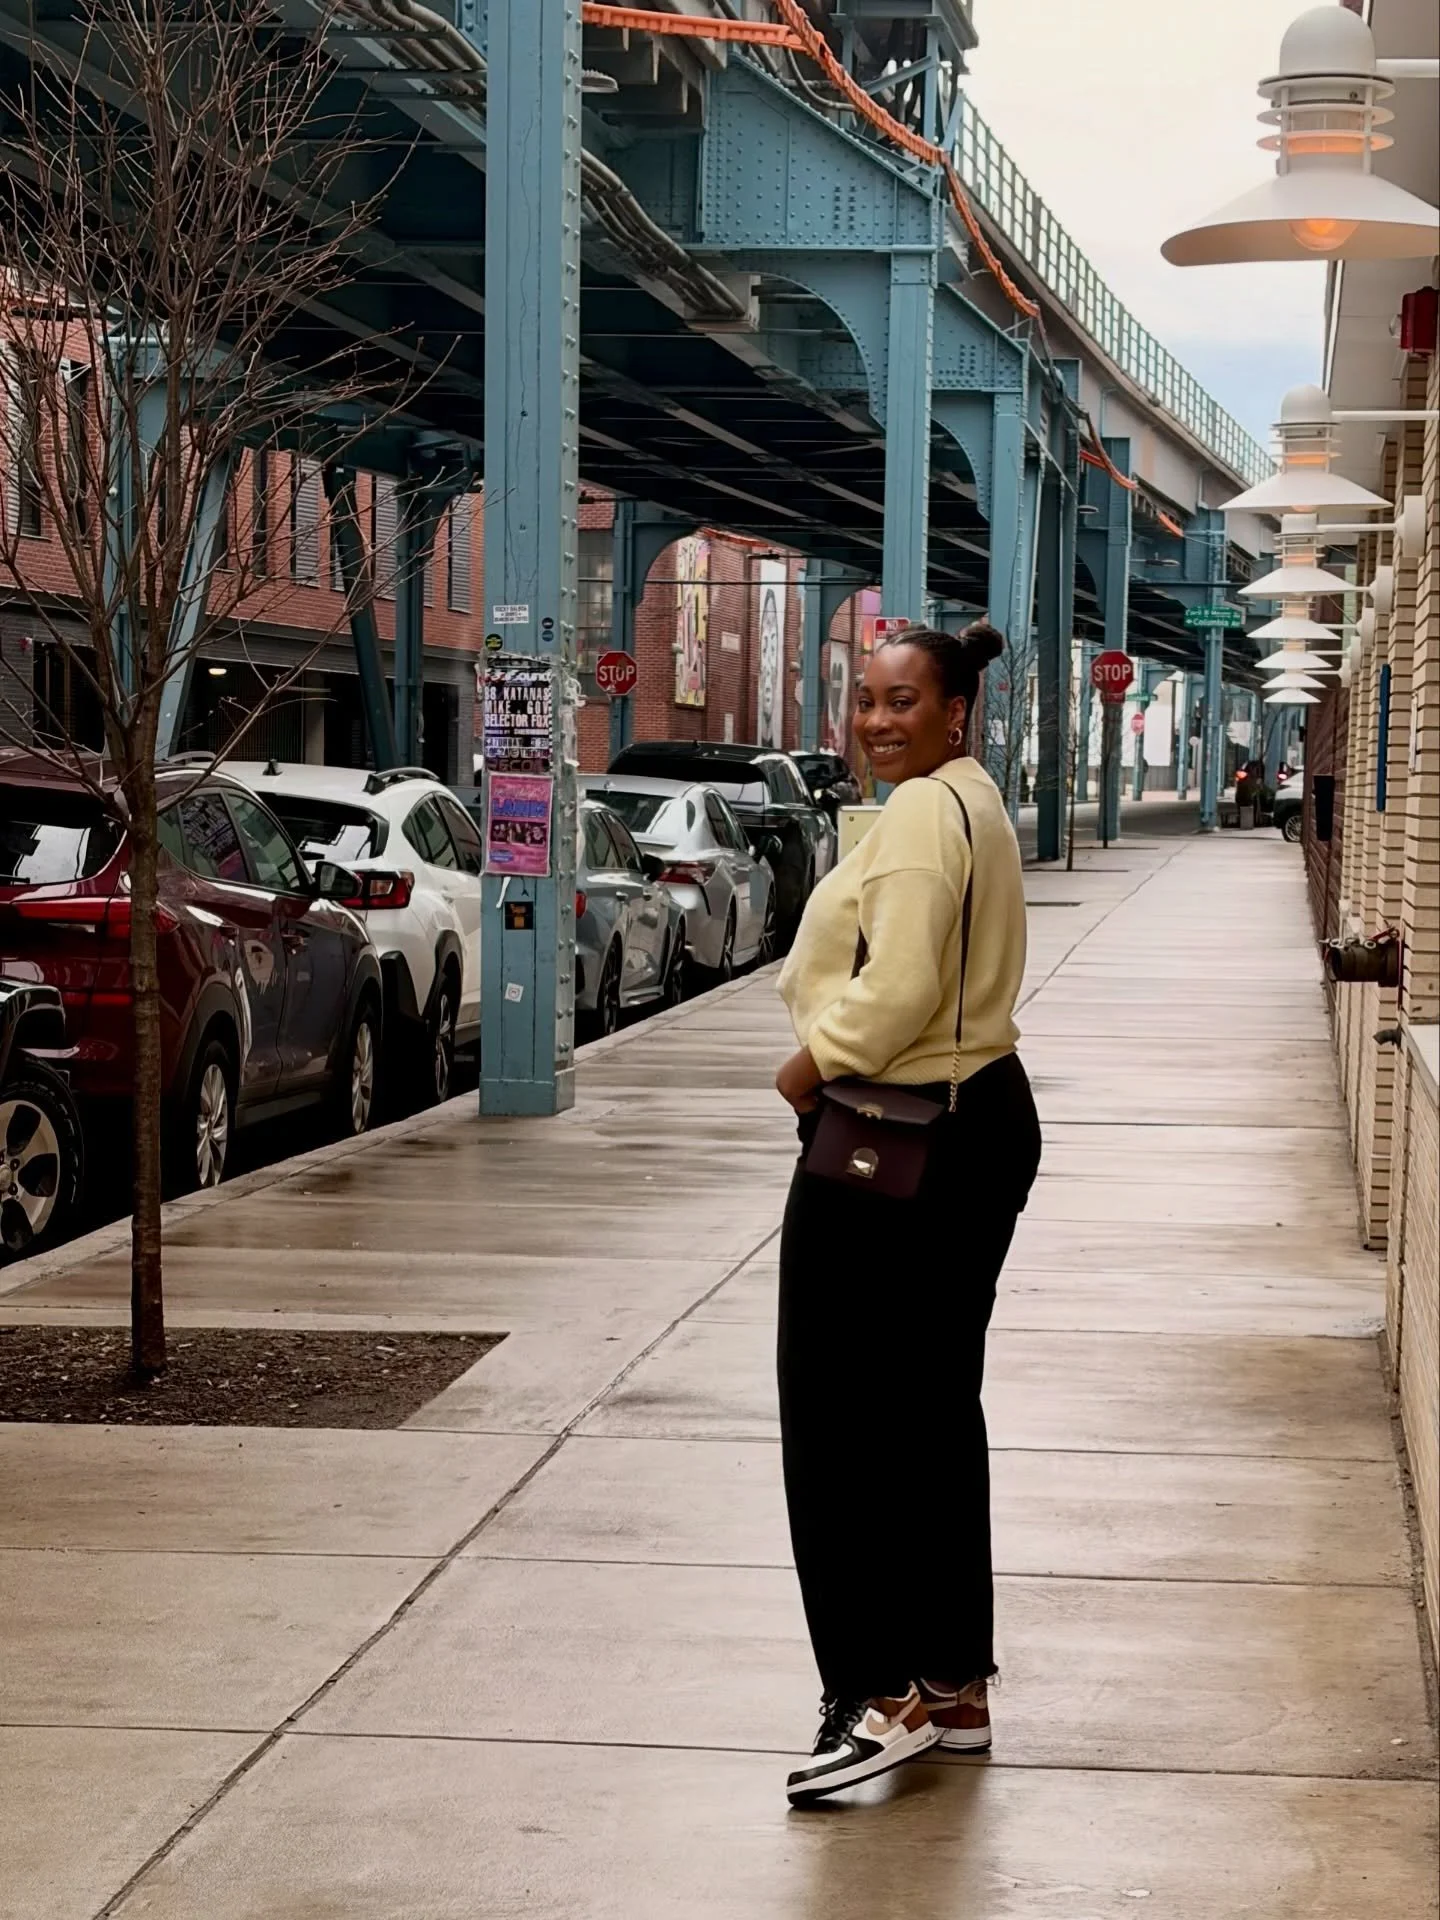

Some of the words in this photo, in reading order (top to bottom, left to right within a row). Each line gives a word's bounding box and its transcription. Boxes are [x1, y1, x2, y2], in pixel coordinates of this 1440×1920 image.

[886, 620, 898, 630] NO
[599, 665, 635, 682] STOP
[1094, 664, 1130, 681] STOP
[503, 687, 549, 700] KATANAS
[484, 701, 511, 714] MIKE
[484, 714, 528, 727] SELECTOR
[531, 714, 549, 727] FOX
